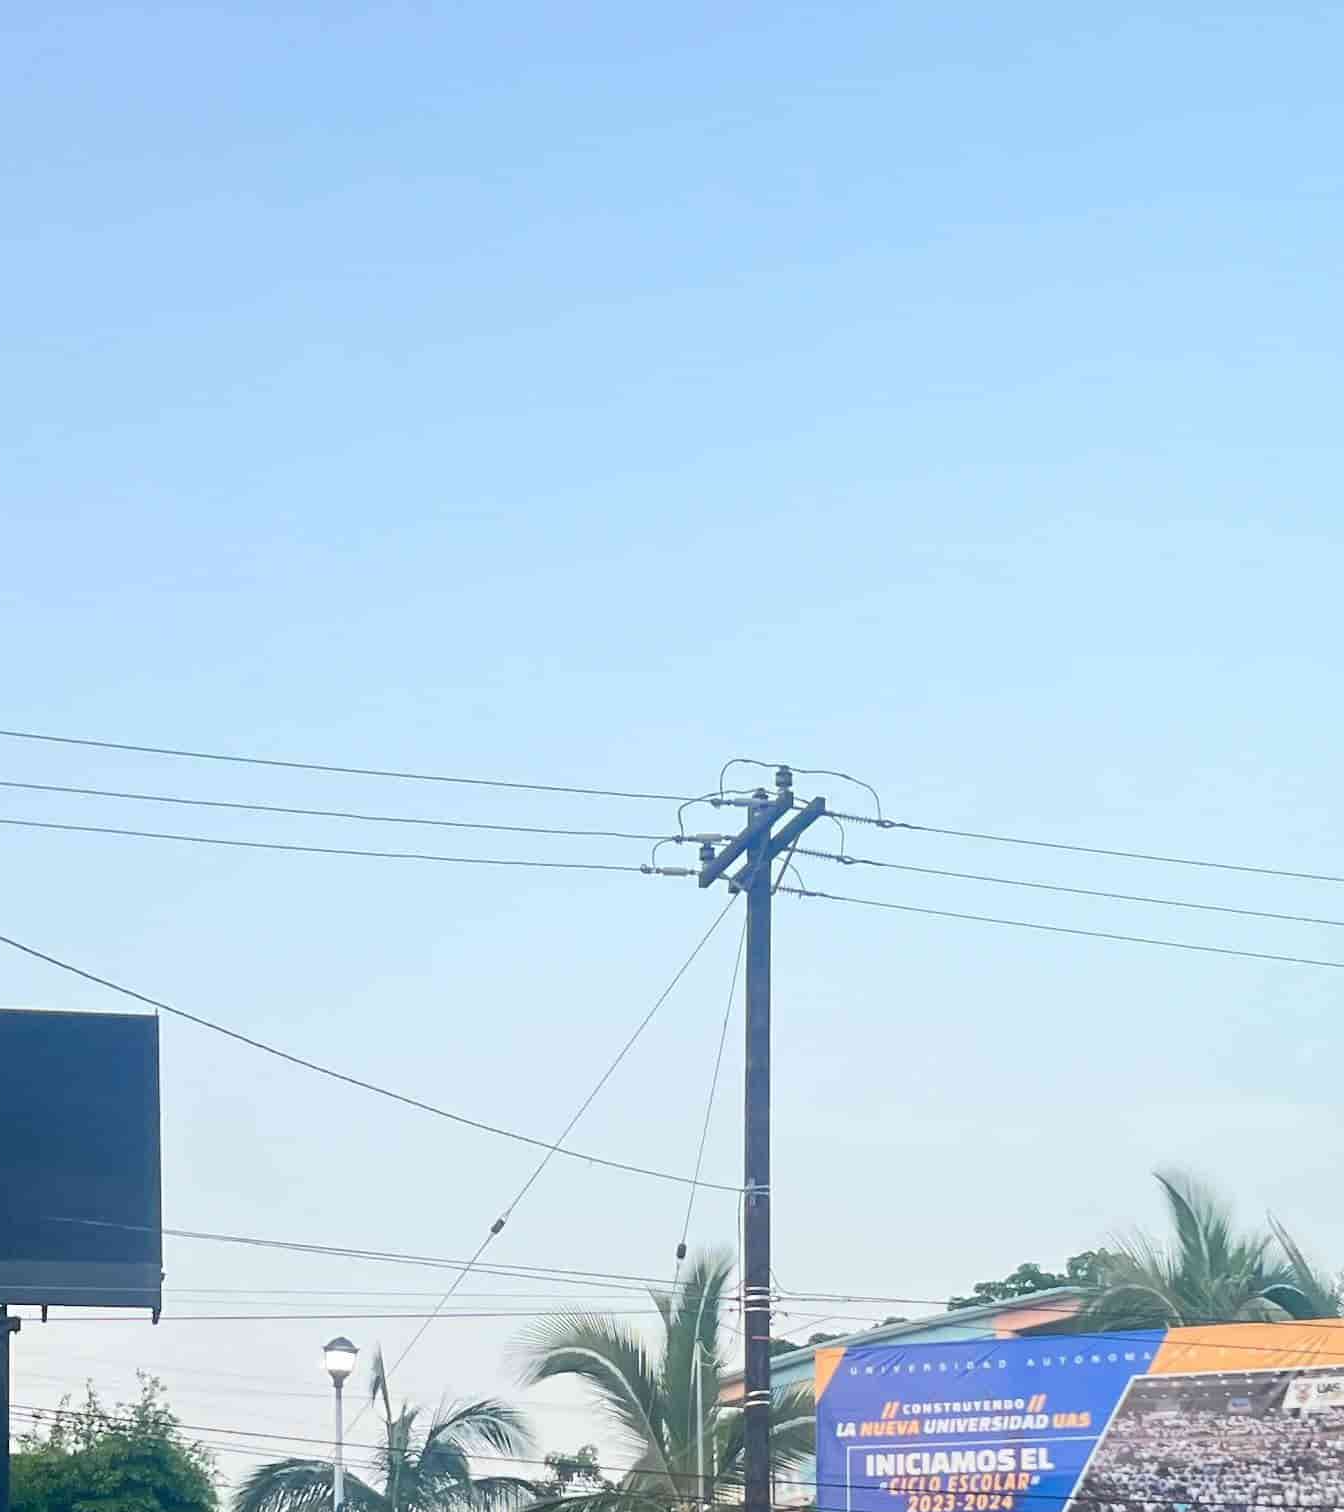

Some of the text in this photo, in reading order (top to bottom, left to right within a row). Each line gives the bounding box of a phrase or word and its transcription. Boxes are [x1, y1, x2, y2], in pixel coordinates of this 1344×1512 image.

[902, 1398, 1025, 1415] CONSTRUYENDO
[836, 1412, 1092, 1437] LA NUEVA UNIVERSIDAD UAS
[865, 1447, 1055, 1477] INICIAMOS EL
